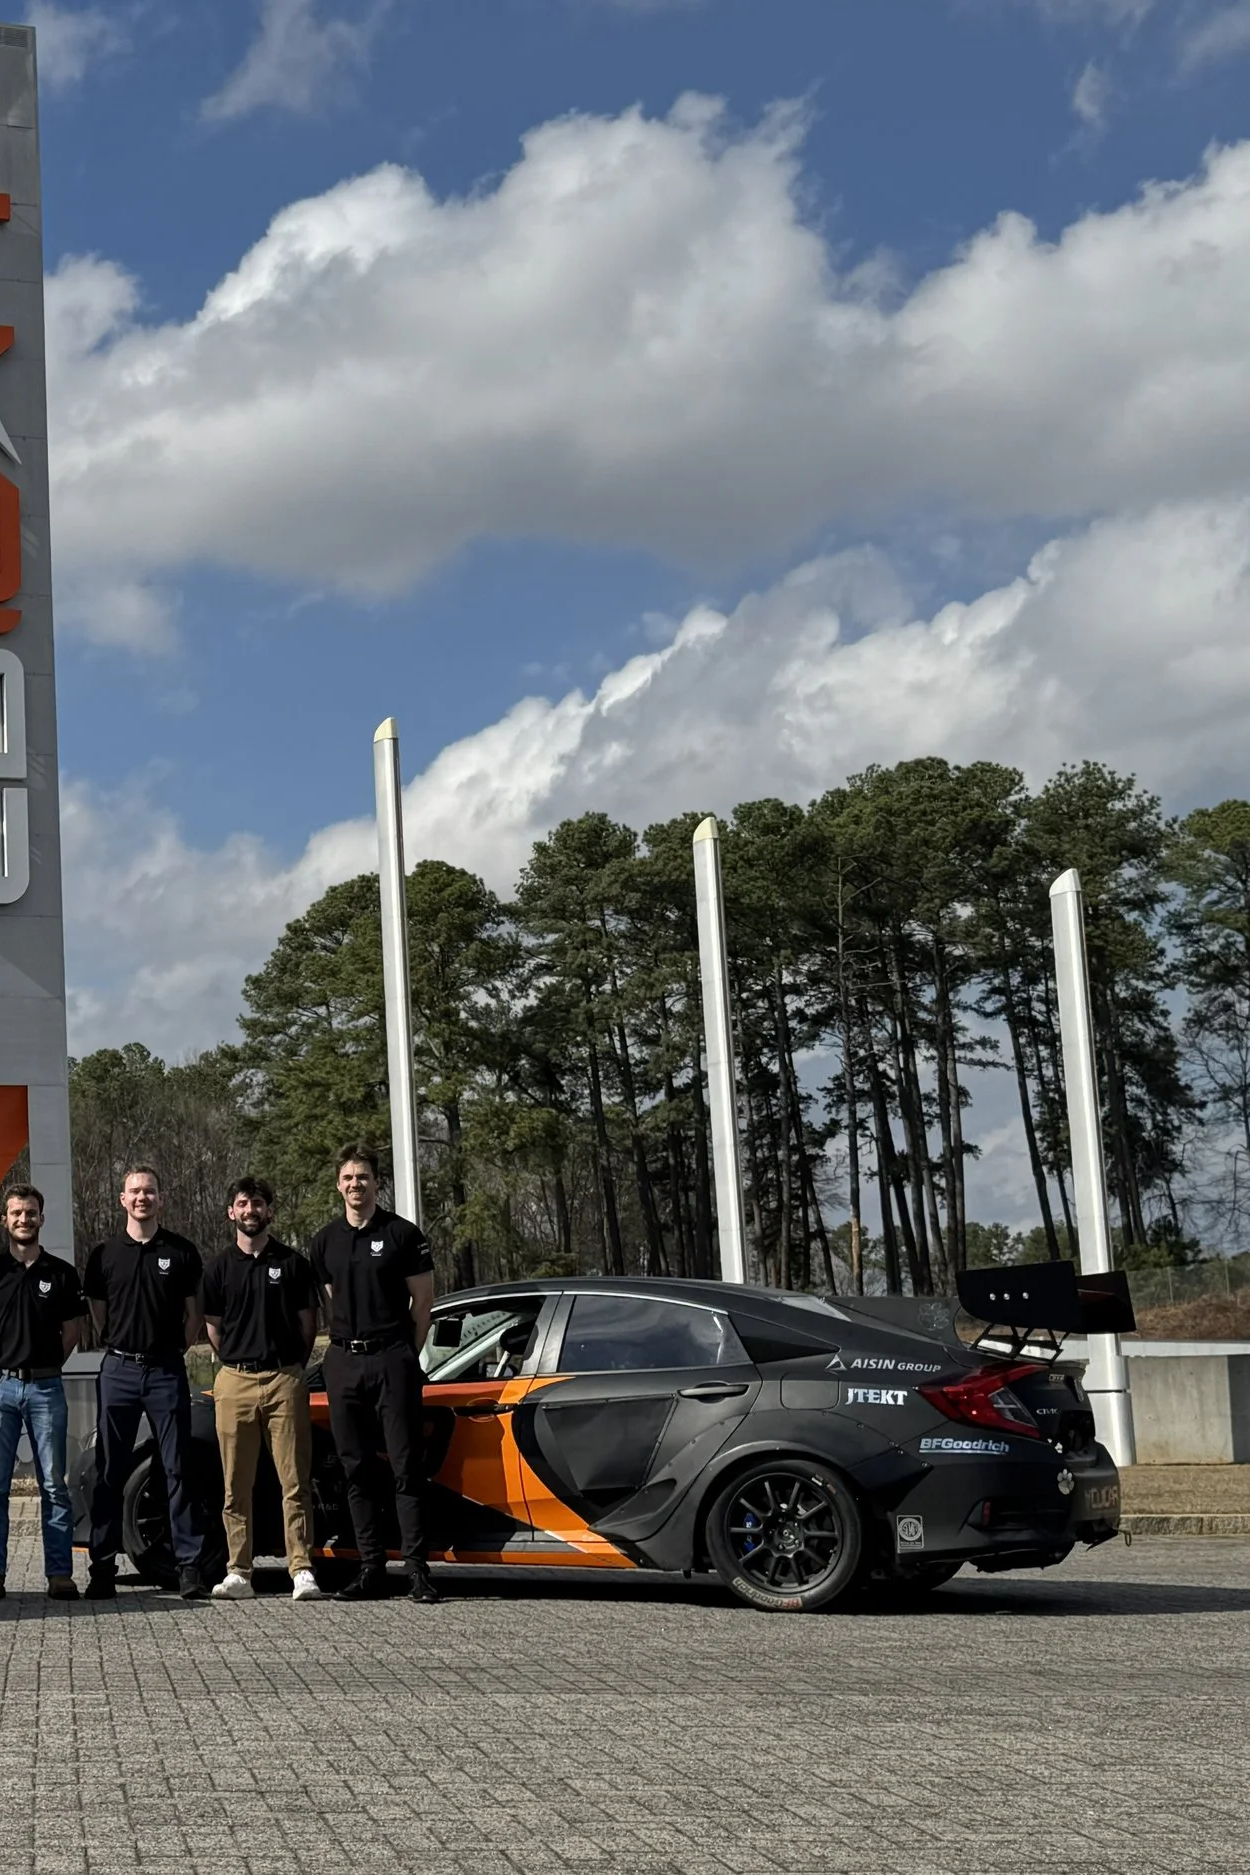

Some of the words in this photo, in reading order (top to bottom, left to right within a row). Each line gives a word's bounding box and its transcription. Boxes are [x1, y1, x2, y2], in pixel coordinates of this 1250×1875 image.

[850, 1358, 895, 1370] AISIN
[897, 1362, 941, 1372] GROUP
[845, 1388, 907, 1405] JTEKT
[919, 1438, 1010, 1453] BFGoodrich
